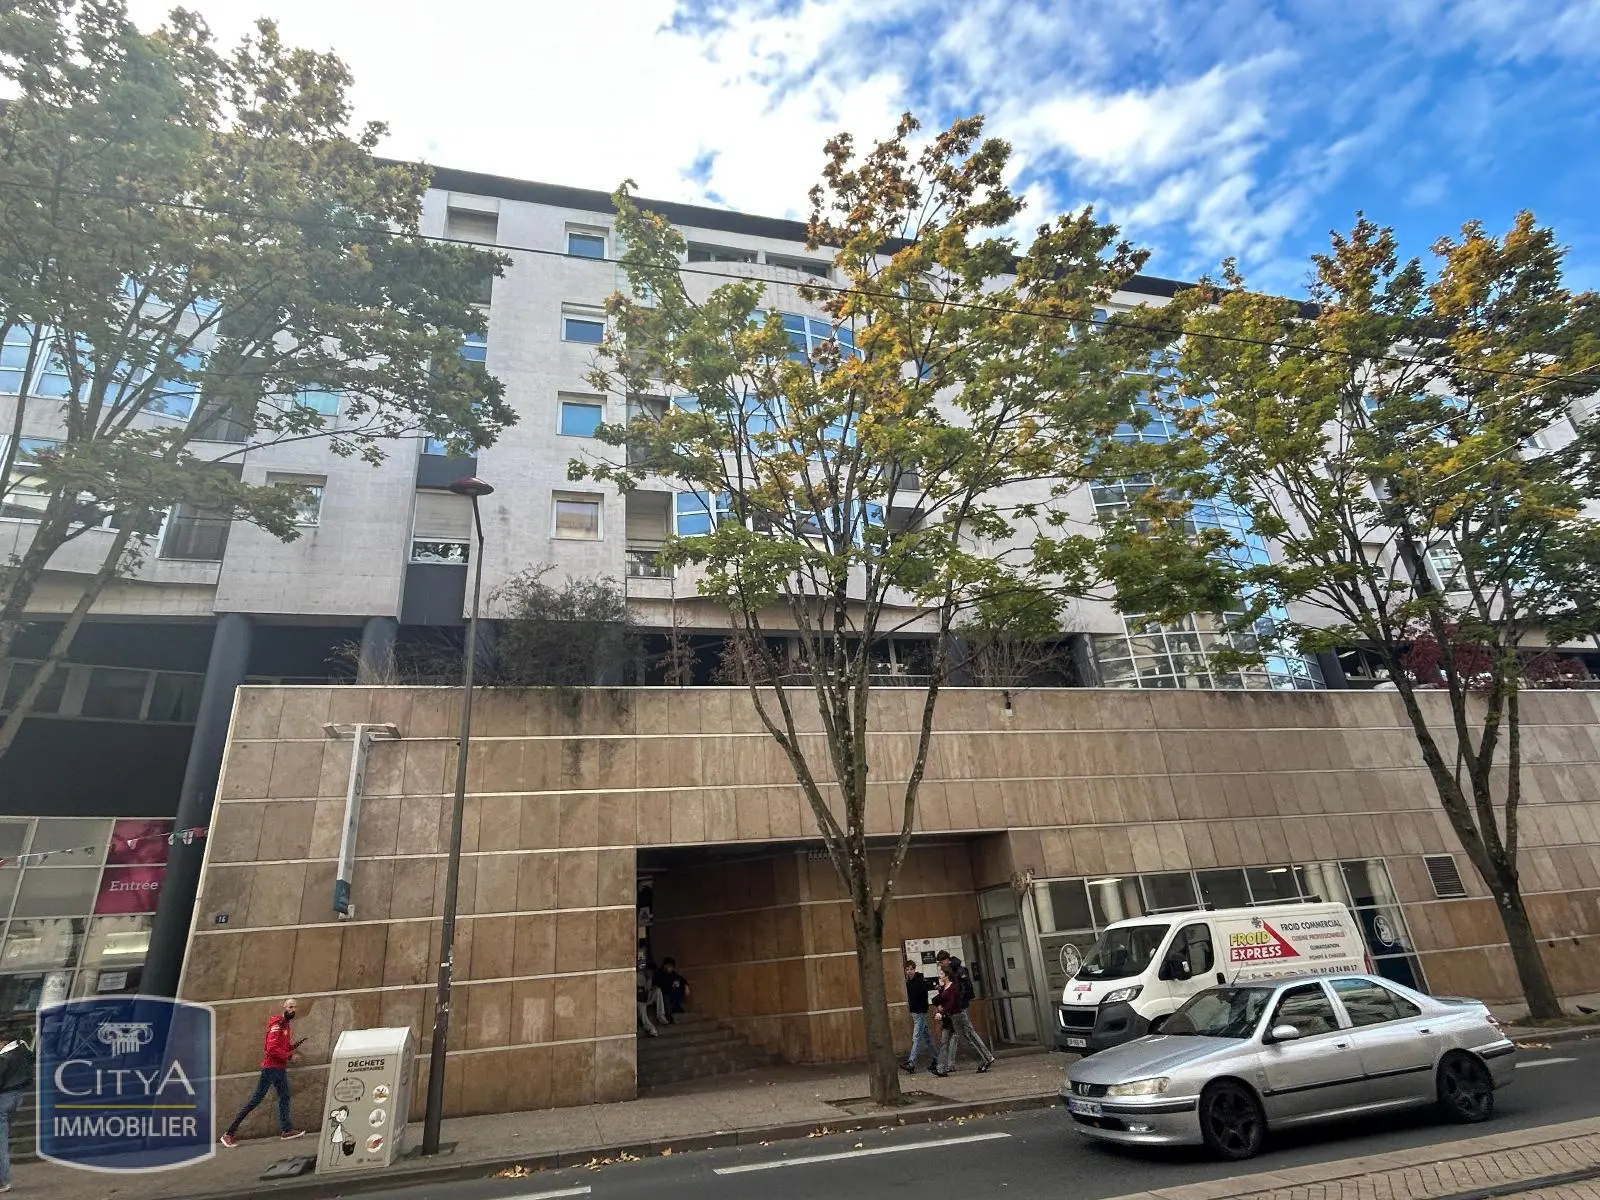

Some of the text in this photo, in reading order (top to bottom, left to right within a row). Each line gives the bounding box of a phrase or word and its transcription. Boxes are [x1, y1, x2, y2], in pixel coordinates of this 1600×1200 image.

[109, 880, 159, 892] Entrée
[1281, 919, 1343, 932] FROID COMMERCIAL
[1229, 931, 1271, 947] FROID
[1232, 946, 1282, 960] EXPRESS
